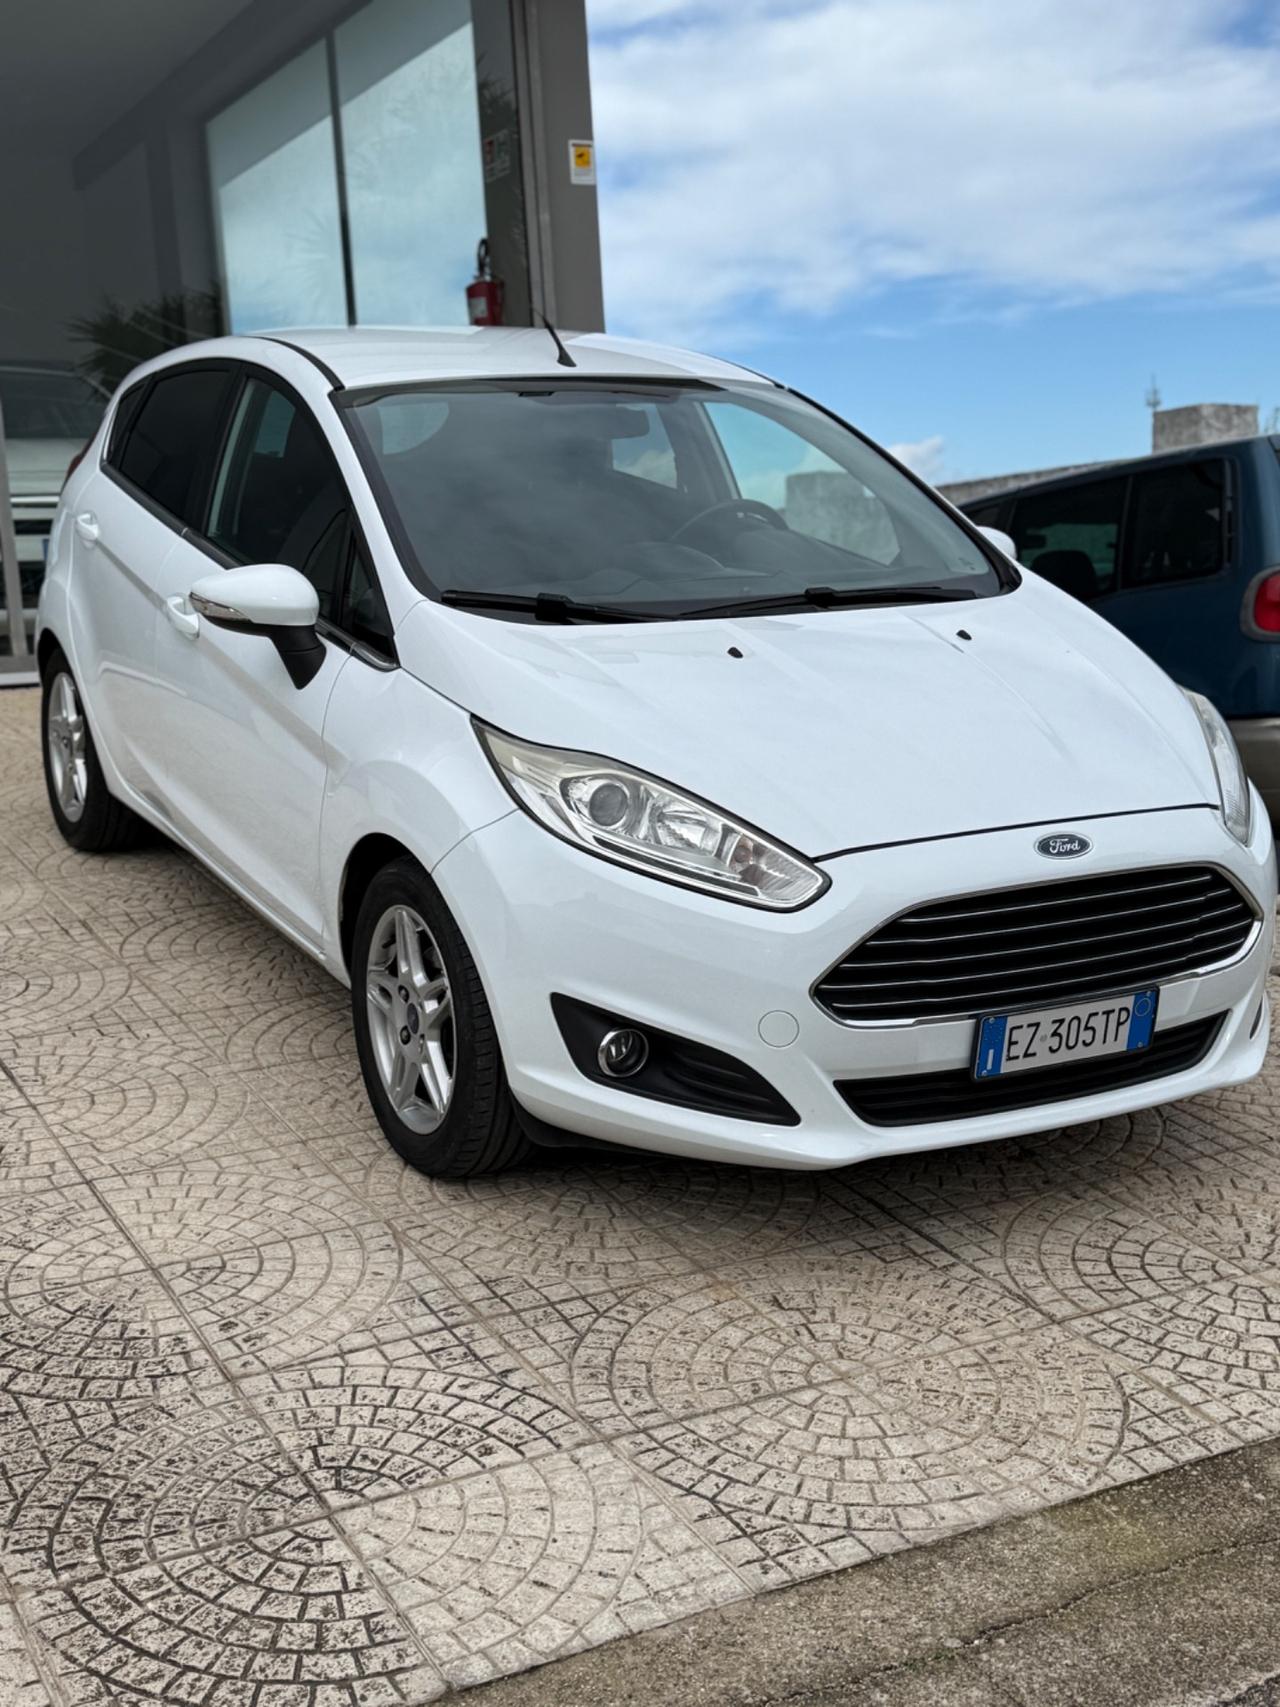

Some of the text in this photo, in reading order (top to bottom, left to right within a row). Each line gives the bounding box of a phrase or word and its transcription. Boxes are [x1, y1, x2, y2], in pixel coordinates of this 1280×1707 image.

[1049, 838, 1080, 853] Ford
[1005, 1006, 1131, 1061] EZ 305TP
